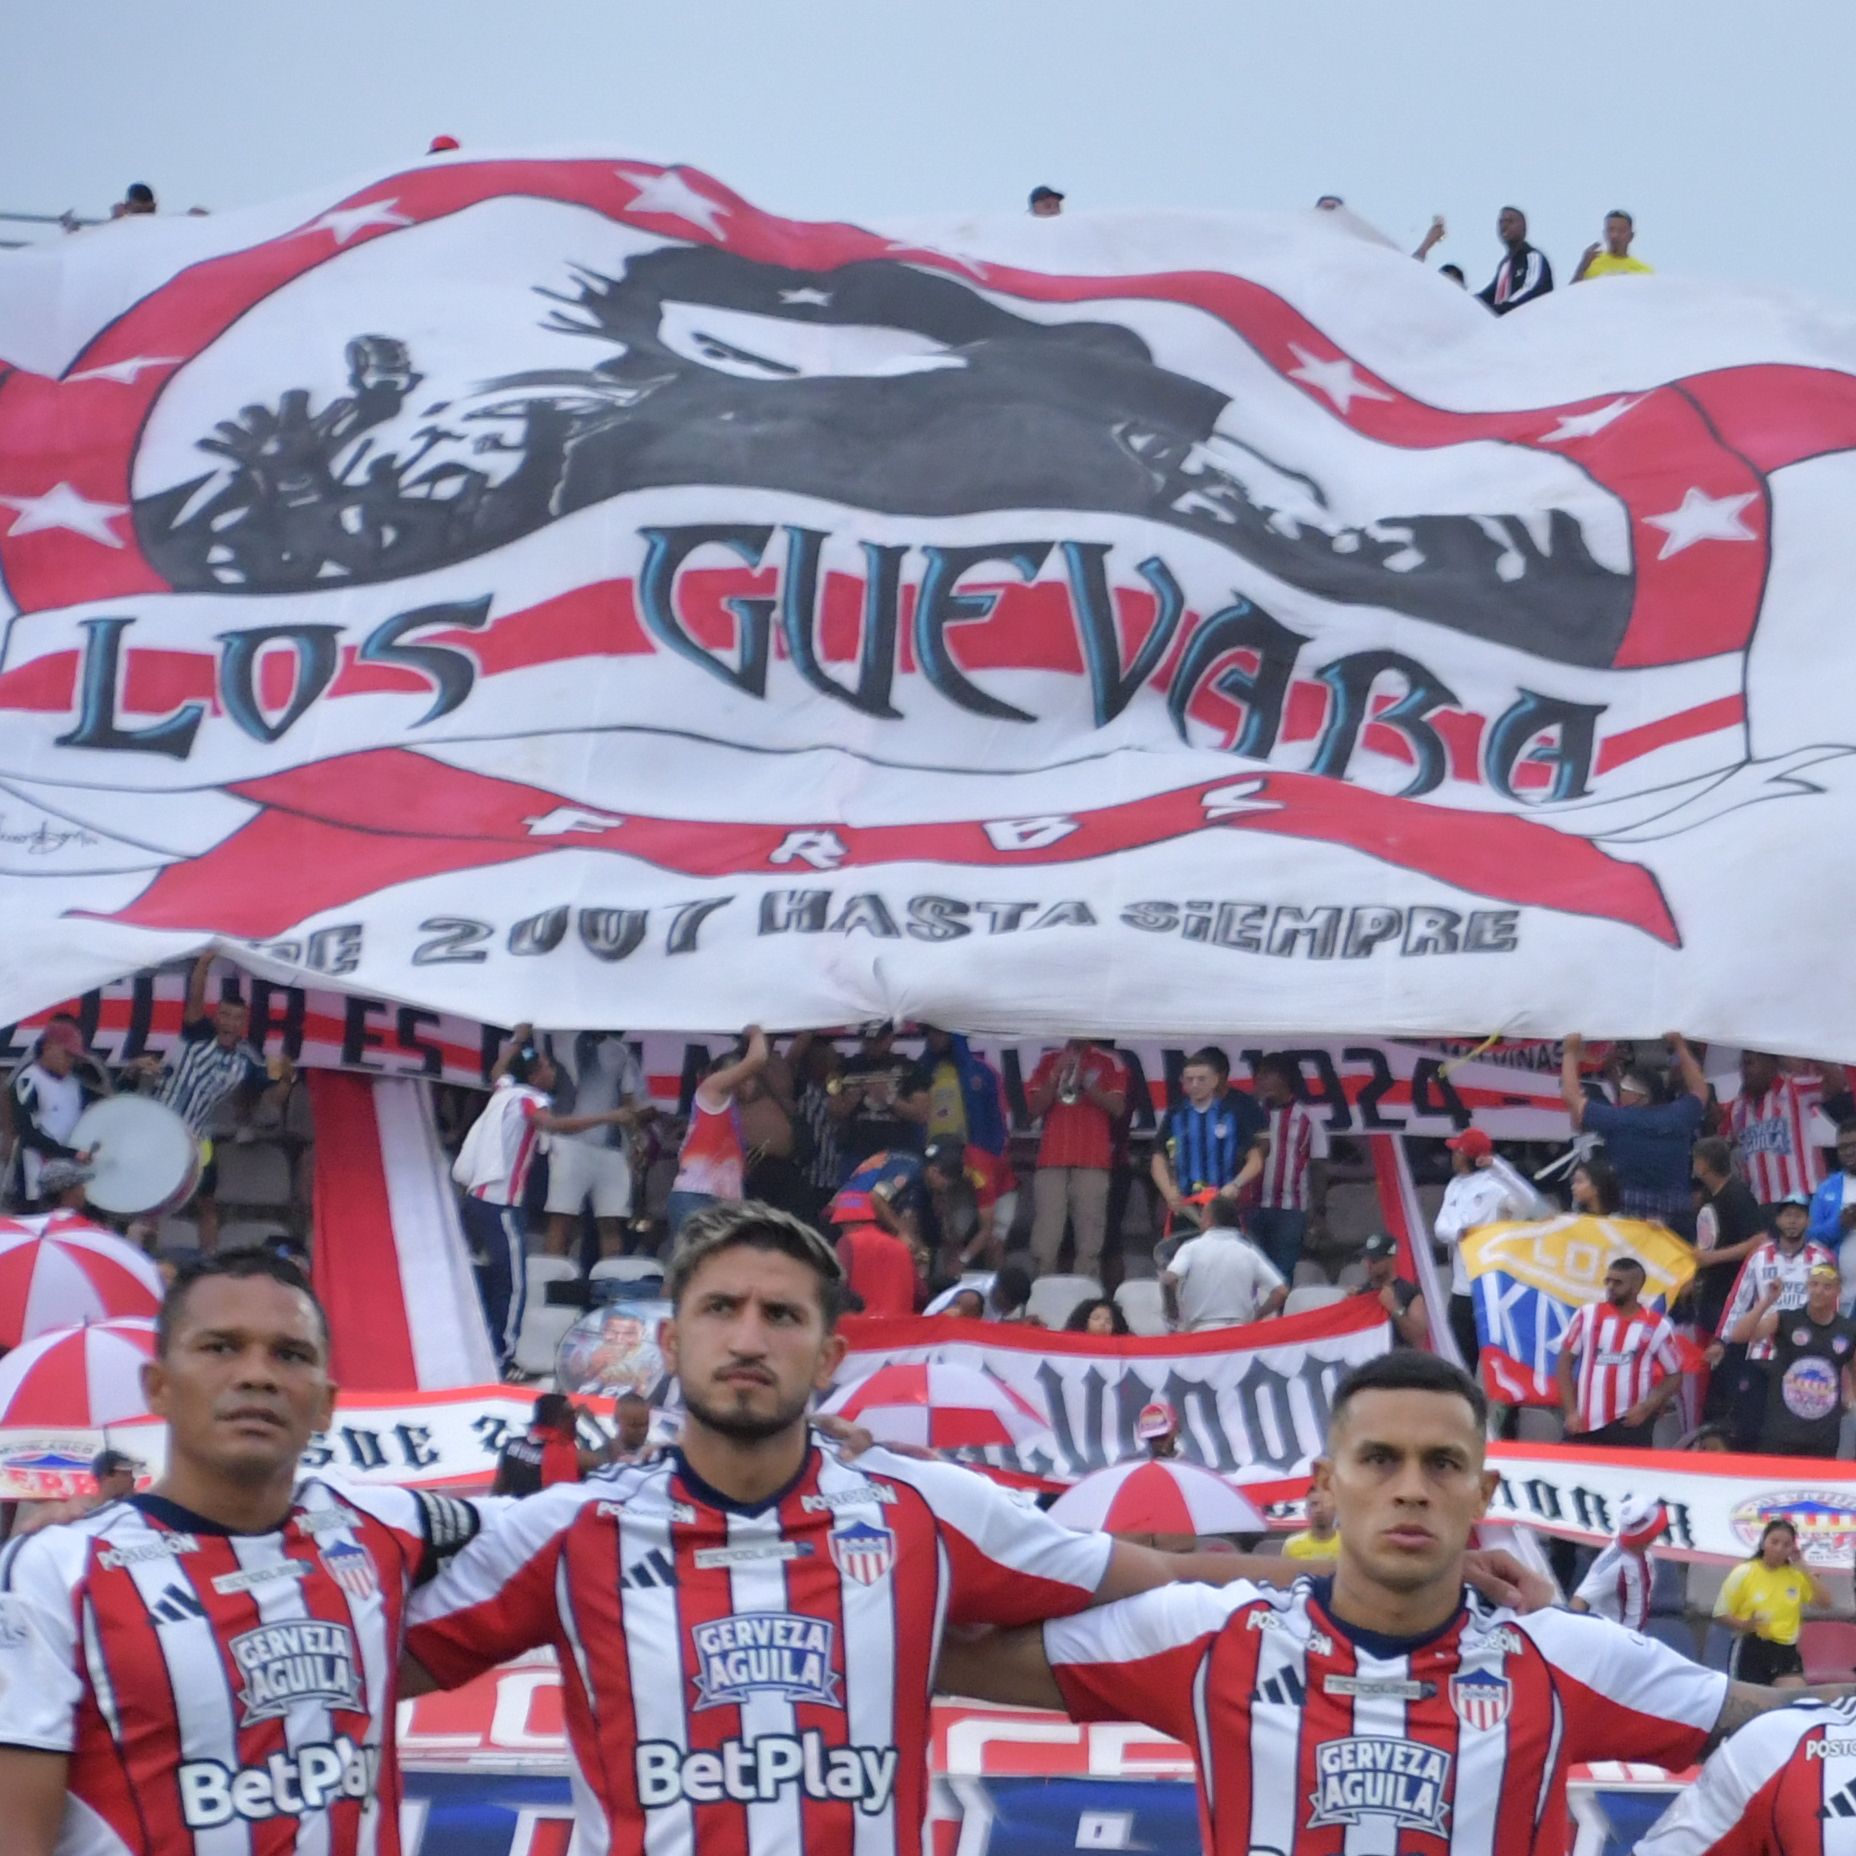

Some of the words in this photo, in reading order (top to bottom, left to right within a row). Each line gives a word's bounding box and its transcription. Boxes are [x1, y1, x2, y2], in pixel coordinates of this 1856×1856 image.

[54, 594, 494, 762] LOS
[637, 522, 1607, 803] GUEVARA
[412, 894, 735, 965] 2007
[757, 888, 1095, 942] HASTA
[253, 1661, 351, 1702] AGUILA
[710, 1649, 823, 1687] AGUILA
[635, 1732, 897, 1816] BetPlay
[1325, 1775, 1433, 1816] AGUILA
